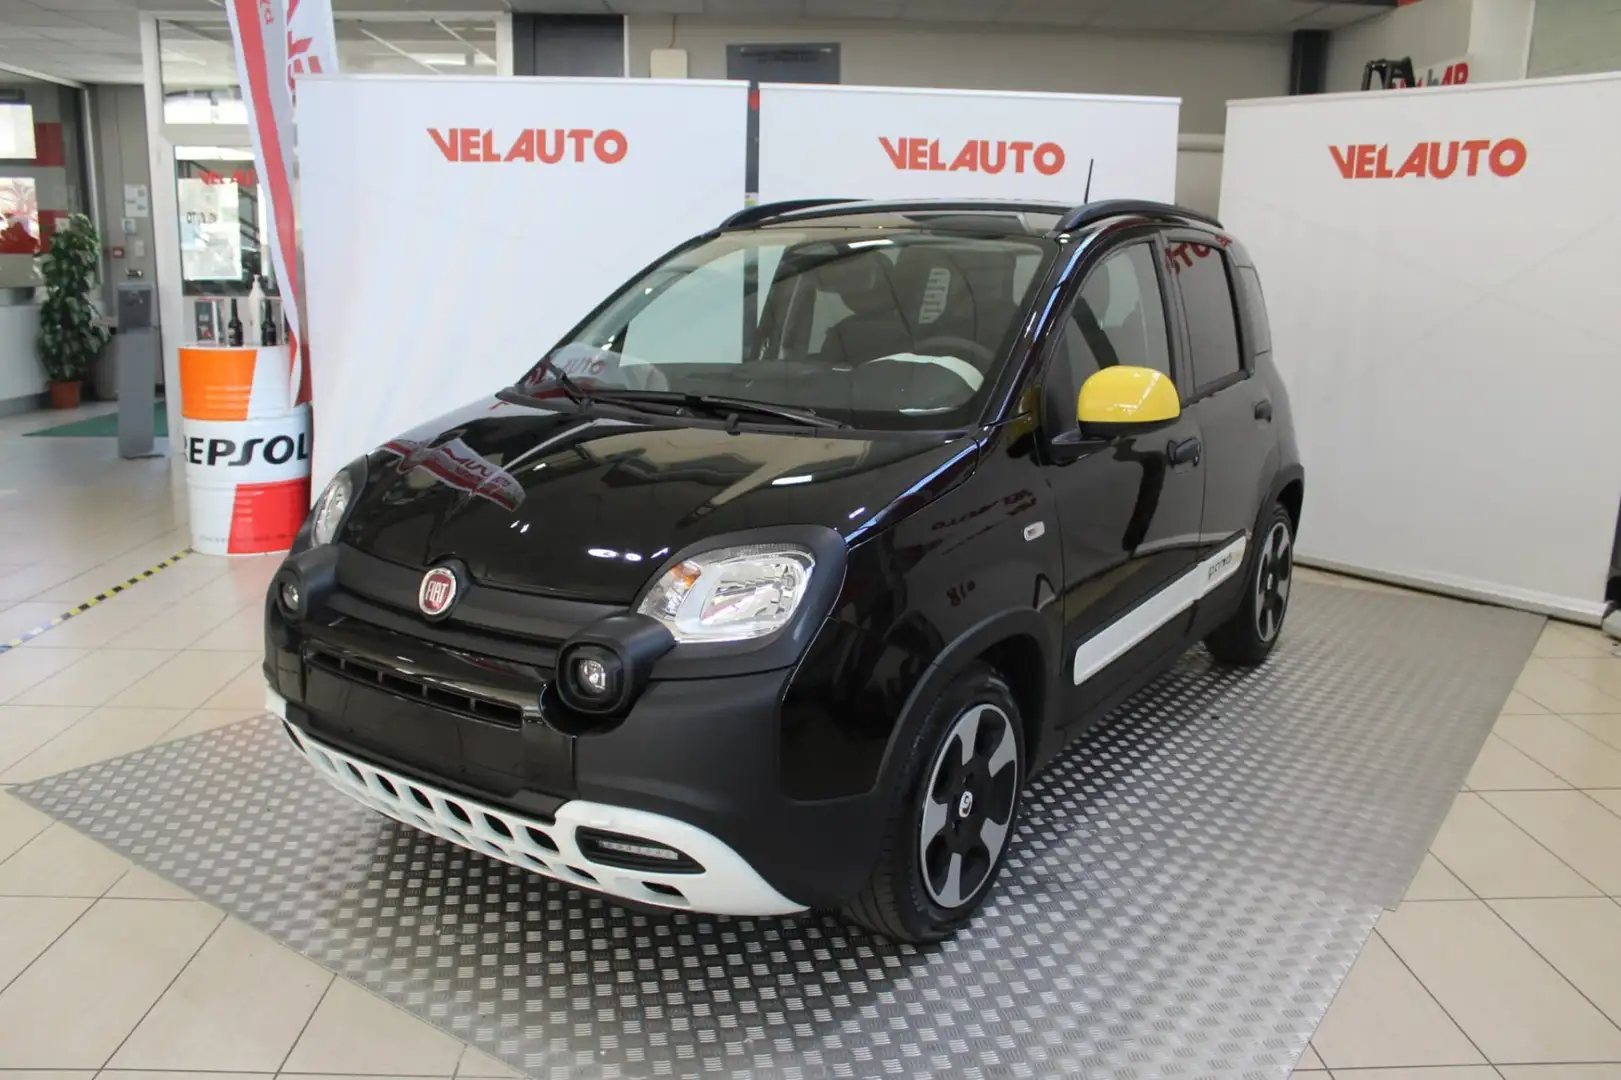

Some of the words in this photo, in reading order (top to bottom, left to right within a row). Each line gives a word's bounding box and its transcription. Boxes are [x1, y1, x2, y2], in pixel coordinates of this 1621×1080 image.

[426, 128, 628, 164] VELAUTO
[878, 136, 1065, 175] VELAUTO
[1328, 138, 1527, 179] VELAUTO
[425, 580, 449, 603] FIAT
